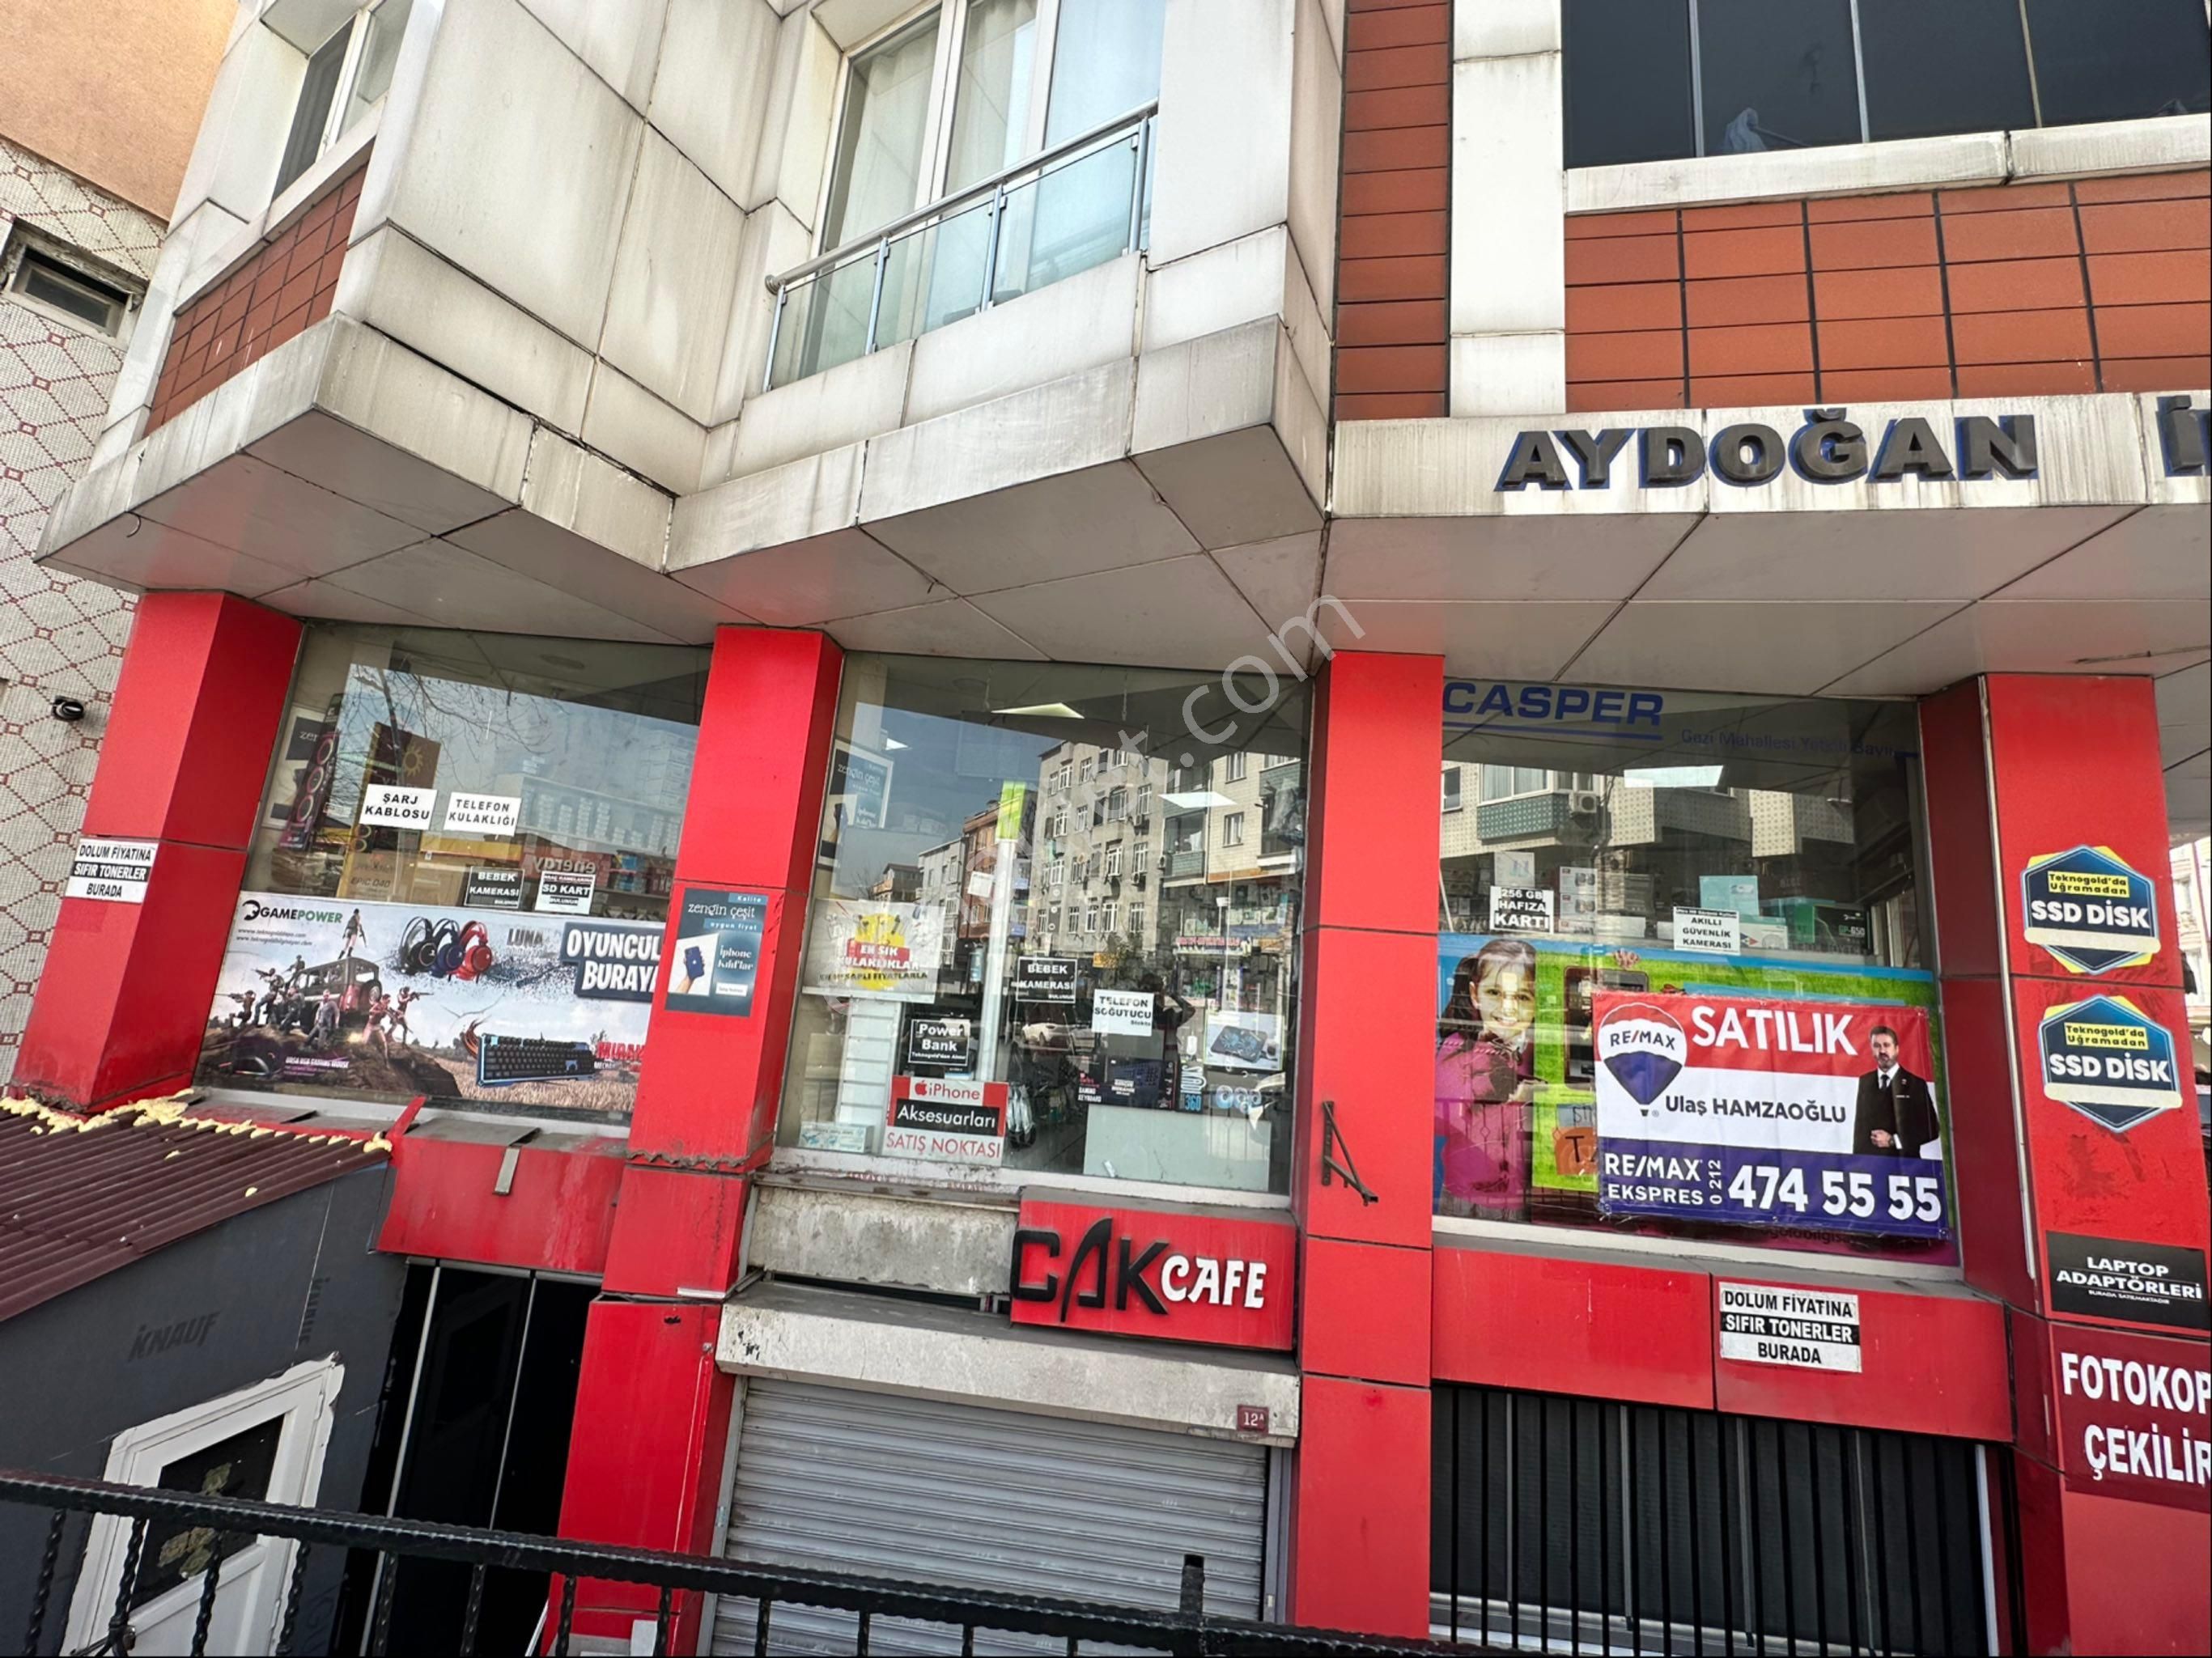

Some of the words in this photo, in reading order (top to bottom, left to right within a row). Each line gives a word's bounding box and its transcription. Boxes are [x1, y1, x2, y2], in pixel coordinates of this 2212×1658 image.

[1494, 407, 2039, 491] AYDOĞAN
[2155, 394, 2210, 477] İ
[1441, 681, 1664, 727] CASPER
[1681, 728, 1714, 744] Gazi
[1718, 731, 1795, 751] Mahallesi
[382, 792, 418, 805] ŞARJ
[455, 798, 511, 813] TELEFON
[364, 804, 431, 821] KABLOSU
[448, 812, 516, 827] KULAKLIĞI
[79, 844, 111, 859] DOLUM
[111, 845, 151, 862] FİYATINA
[74, 863, 99, 877] SIFIR
[99, 864, 147, 881] TONERLER
[477, 871, 516, 883] BEBEK
[2049, 872, 2128, 887] Teknogold'da
[86, 882, 123, 898] BURADA
[469, 886, 520, 897] KAMERASI
[542, 884, 558, 893] SD
[559, 885, 592, 896] KART
[1501, 888, 1523, 899] 256
[1526, 889, 1545, 900] GB
[2049, 881, 2128, 896] Uğramadan
[260, 906, 343, 924] GAMEPOWER
[688, 903, 727, 917] zengin
[730, 905, 755, 920] çeşit
[1498, 901, 1547, 913] HAFIZA
[2031, 899, 2083, 923] SSD
[2086, 898, 2151, 929] DİSK
[1494, 913, 1550, 930] KARTI
[1691, 917, 1722, 926] AKILLI
[1682, 926, 1731, 938] GÜVENLİK
[1683, 938, 1731, 949] KAMERASI
[1027, 963, 1068, 975] BEBEK
[1019, 980, 1075, 991] KAMERASI
[1098, 995, 1149, 1007] TELEFON
[1093, 1007, 1153, 1020] SOĞUTUCU
[918, 1023, 964, 1037] Power
[1690, 1005, 1859, 1057] SATILIK
[2066, 1024, 2146, 1039] Teknogold'da
[921, 1039, 958, 1052] Bank
[1609, 1029, 1676, 1051] RE/MAX
[2067, 1034, 2146, 1049] Uğramadan
[2049, 1053, 2102, 1077] SSD
[2105, 1052, 2172, 1083] DİSK
[928, 1083, 981, 1100] iPhone
[896, 1104, 996, 1129] Aksesuarları
[1665, 1094, 1708, 1115] Ulaş
[1713, 1097, 1847, 1123] HAMZAOĞLU
[885, 1131, 927, 1156] SATIŞ
[931, 1138, 1001, 1159] NOKTASI
[1604, 1152, 1702, 1182] RE/MAX
[1709, 1159, 1723, 1191] 212
[1607, 1185, 1704, 1206] EKSPRES
[1727, 1164, 1809, 1213] 474
[1822, 1170, 1875, 1218] 55
[1887, 1174, 1942, 1223] 55
[2086, 1256, 2170, 1278] LAPTOP
[1160, 1254, 1267, 1309] CAFE
[2056, 1270, 2203, 1300] ADAPTÖRLERİ
[1724, 1290, 1778, 1310] DOLUM
[1782, 1295, 1853, 1319] FİYATINA
[1725, 1313, 1766, 1334] SIFIR
[1768, 1317, 1853, 1343] TONERLER
[1757, 1342, 1822, 1364] BURADA
[2060, 1351, 2211, 1415] FOTOKOP
[1243, 1411, 1264, 1427] 12A
